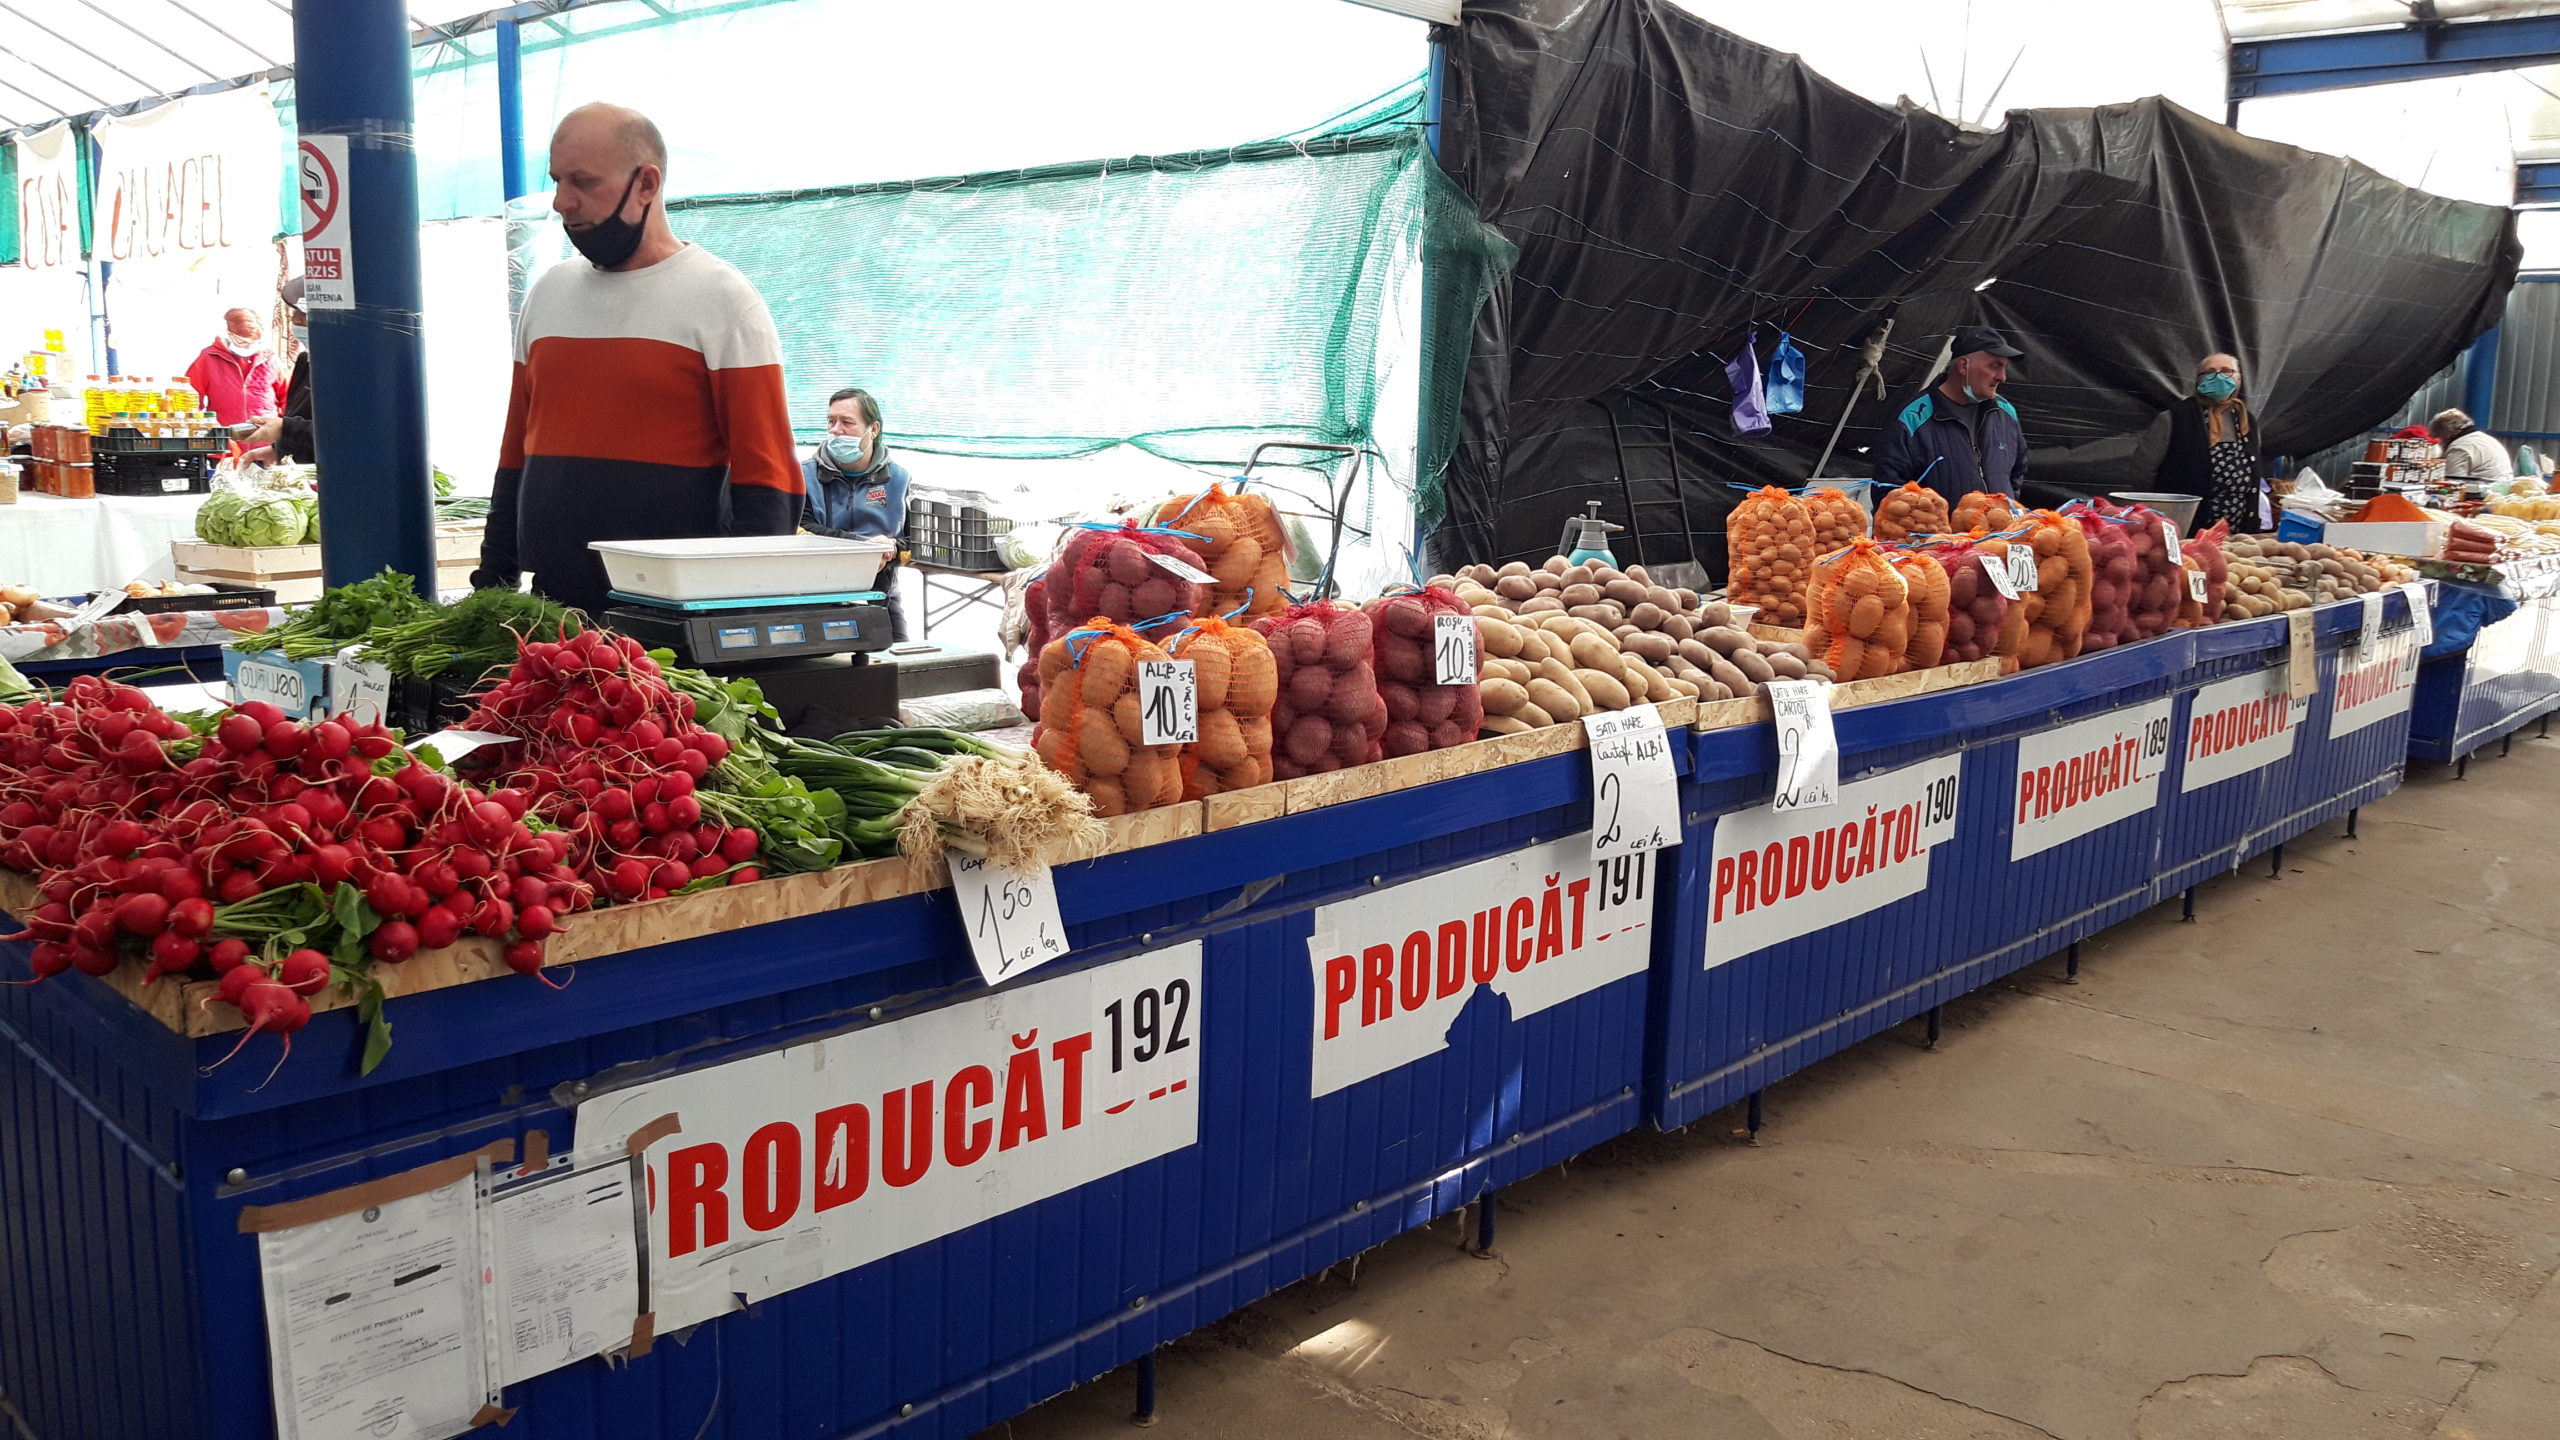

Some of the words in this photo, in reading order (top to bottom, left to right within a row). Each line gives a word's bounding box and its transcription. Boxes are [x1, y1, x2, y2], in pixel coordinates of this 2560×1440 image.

[2010, 557, 2030, 588] 20
[2192, 577, 2206, 595] 10
[1437, 635, 1464, 683] 10
[1144, 685, 1178, 737] 10
[1595, 722, 1618, 738] SATU
[2142, 716, 2169, 760] 189
[2188, 688, 2294, 762] PRODUCĂTO
[1776, 727, 1801, 808] 2
[2018, 731, 2157, 825] PRODUCĂT
[1596, 772, 1621, 849] 2
[1924, 774, 1957, 828] 190
[1597, 850, 1646, 912] 191
[1324, 871, 1646, 1041] PRODUCĂT
[1104, 978, 1193, 1074] 192
[641, 1027, 1188, 1258] RODUCĂT
